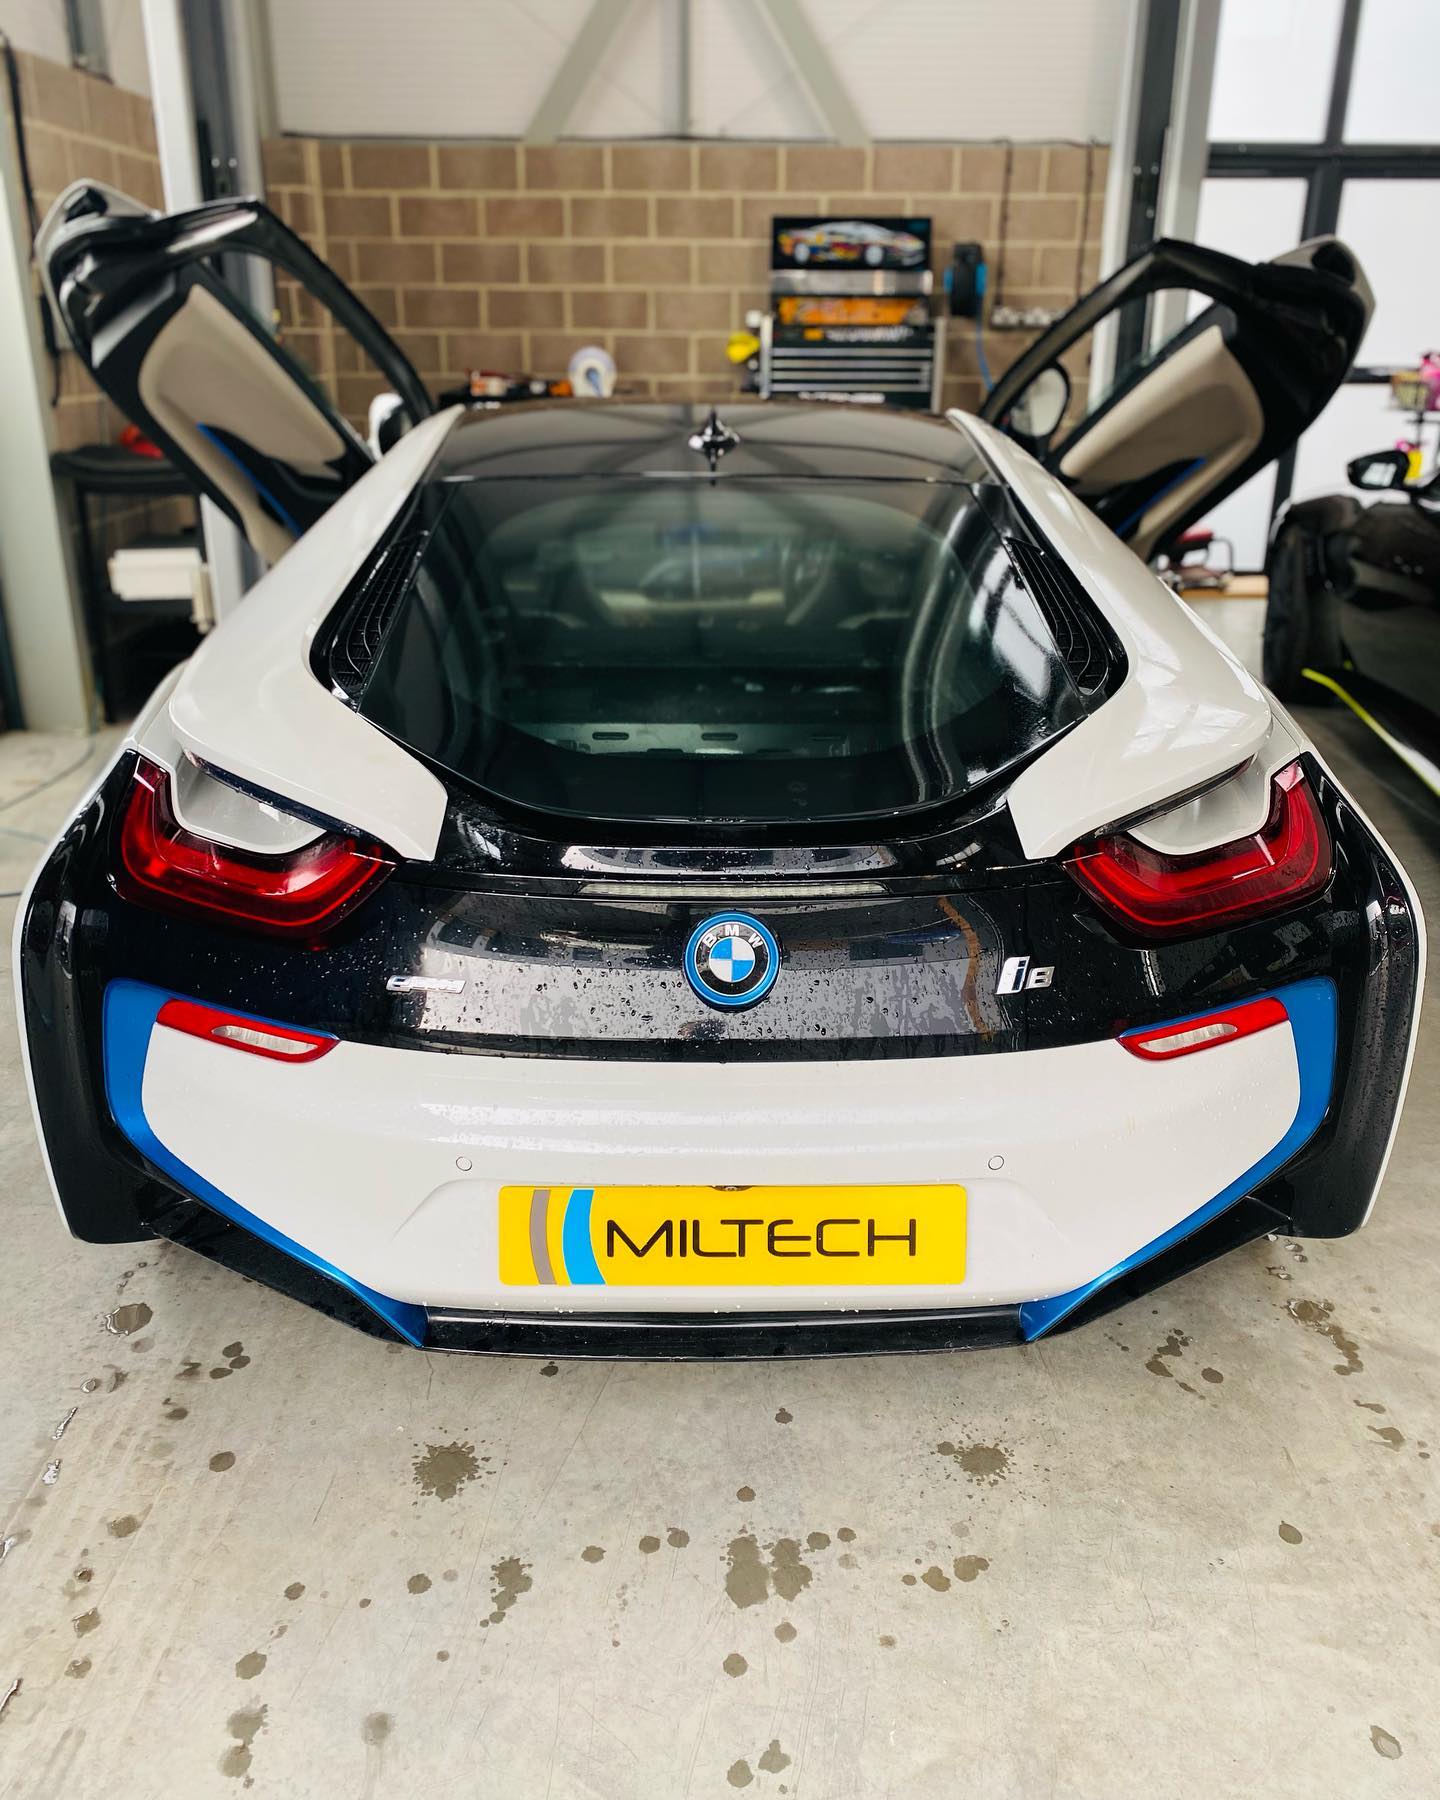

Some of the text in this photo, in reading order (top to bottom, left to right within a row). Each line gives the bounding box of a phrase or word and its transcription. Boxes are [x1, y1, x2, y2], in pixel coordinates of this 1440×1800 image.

[702, 924, 763, 948] BMW
[995, 956, 1055, 994] i8
[606, 1218, 916, 1258] MILTECH
